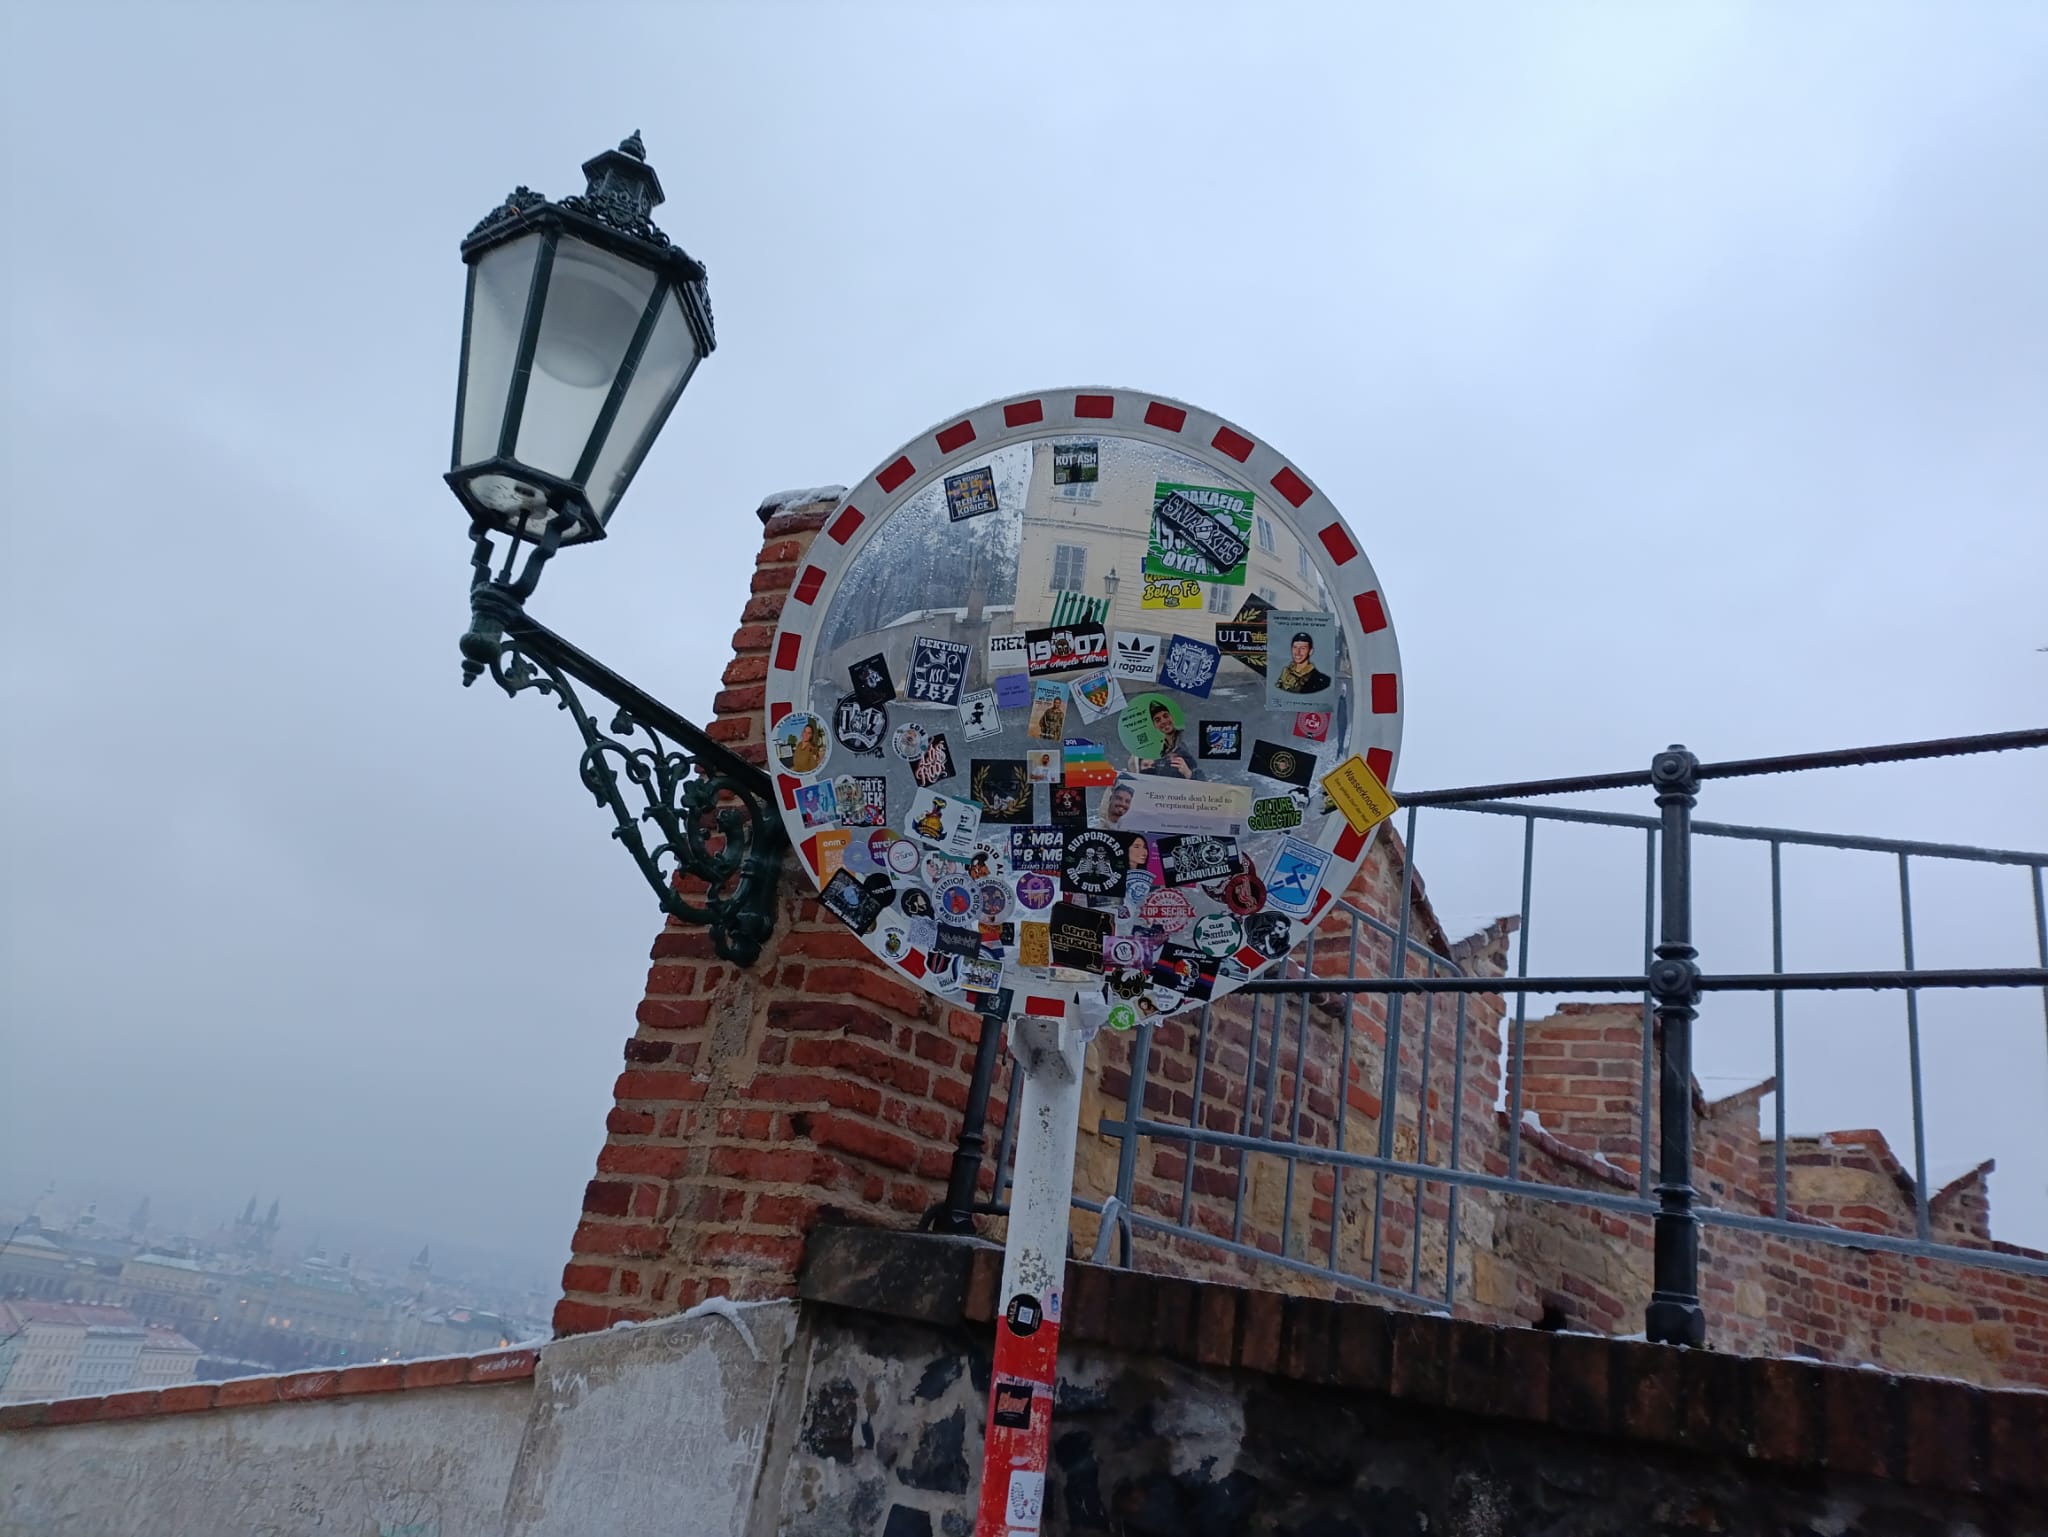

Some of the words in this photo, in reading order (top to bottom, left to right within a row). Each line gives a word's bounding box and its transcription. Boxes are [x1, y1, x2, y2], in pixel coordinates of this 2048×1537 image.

[1172, 489, 1245, 513] ΡΑΚΛΕΙΟ
[919, 638, 968, 654] SEKTION
[928, 668, 945, 683] KSC
[1118, 662, 1155, 674] ragazzi
[1188, 794, 1207, 802] don't
[1208, 795, 1224, 803] lead
[1344, 767, 1381, 817] Wasserknoden
[1155, 802, 1195, 810] exceptional
[1253, 796, 1295, 815] CULTURE
[1248, 811, 1302, 831] COLLECTIVE
[974, 843, 1000, 860] DDIO
[1067, 831, 1125, 857] SUPPORTERS
[935, 877, 964, 900] ATTENTION
[1081, 881, 1101, 893] SUR
[1143, 906, 1159, 916] TOP
[1161, 906, 1192, 916] SECRET
[1061, 924, 1097, 939] BEITAR
[1202, 927, 1234, 940] Santos
[1207, 938, 1230, 946] LAGUNA
